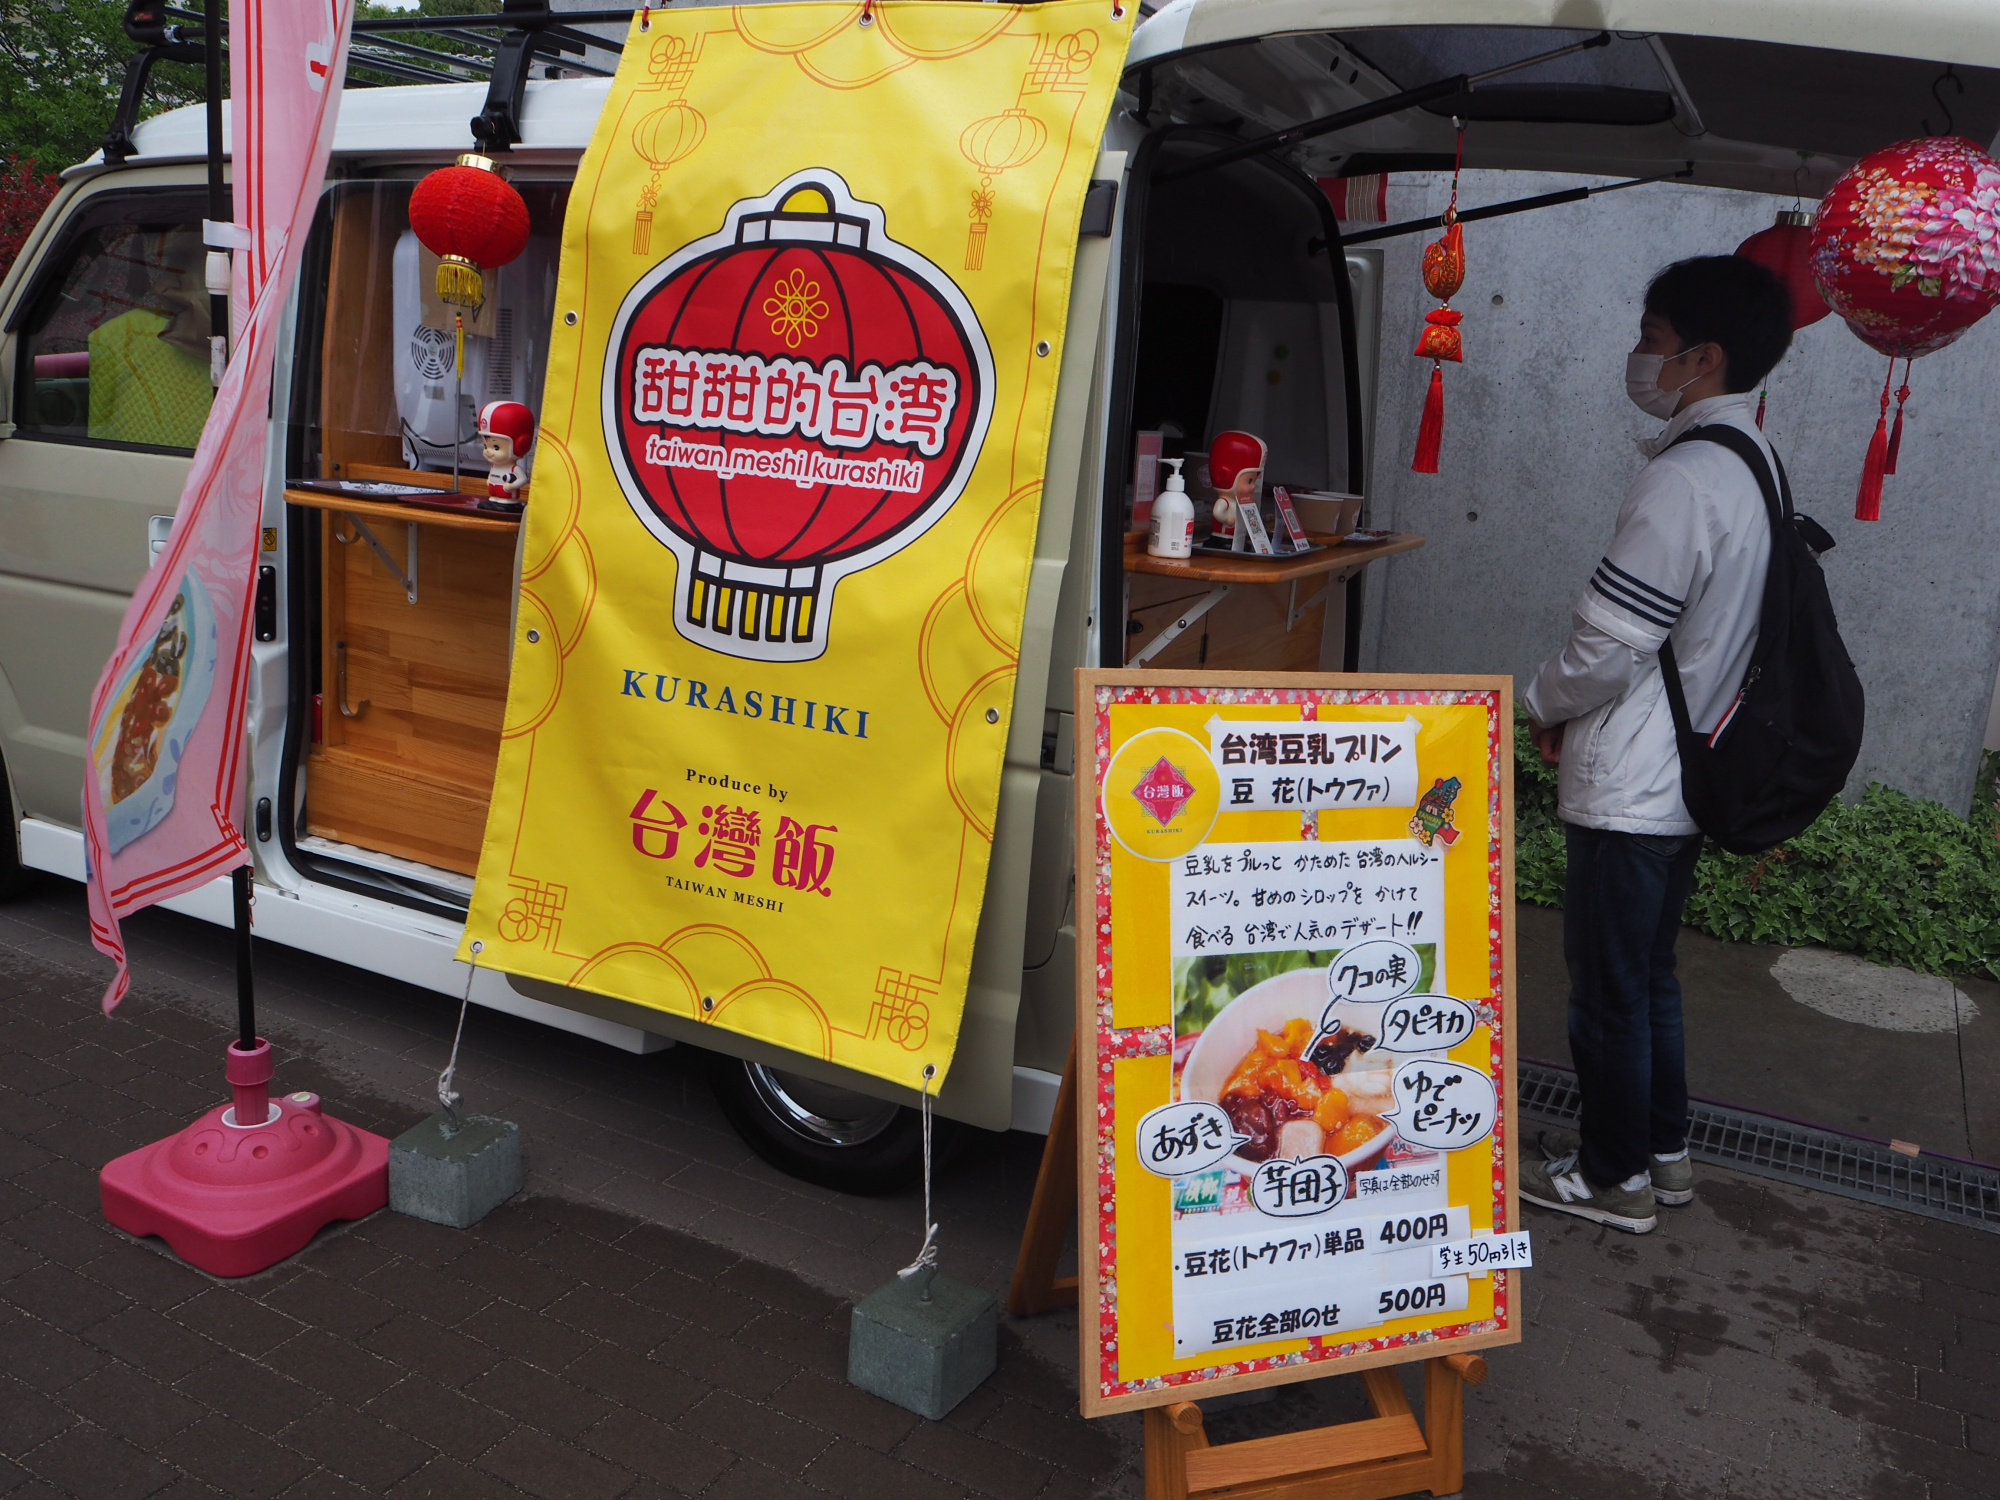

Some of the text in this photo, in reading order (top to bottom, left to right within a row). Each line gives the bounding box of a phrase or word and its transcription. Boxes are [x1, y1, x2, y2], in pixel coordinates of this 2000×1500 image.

[640, 356, 949, 447] 甜甜的台湾
[620, 668, 870, 739] KURASHIKI
[1220, 732, 1402, 765] 台湾豆乳プリン
[685, 768, 789, 803] Produce by
[629, 788, 839, 897] 台灣飯
[665, 875, 785, 913] TAIWAN MESHI
[1337, 956, 1407, 995] クコの実
[1388, 1005, 1465, 1035] タピオカ
[1402, 1070, 1463, 1104] ゆで
[1151, 1112, 1224, 1162] あずき
[1413, 1103, 1481, 1136] ピーナツ
[1262, 1164, 1343, 1209] 芋団子
[1551, 1172, 1594, 1203] N
[1379, 1213, 1448, 1245] 400円
[1211, 1283, 1446, 1345] 豆花全部のせ 500円
